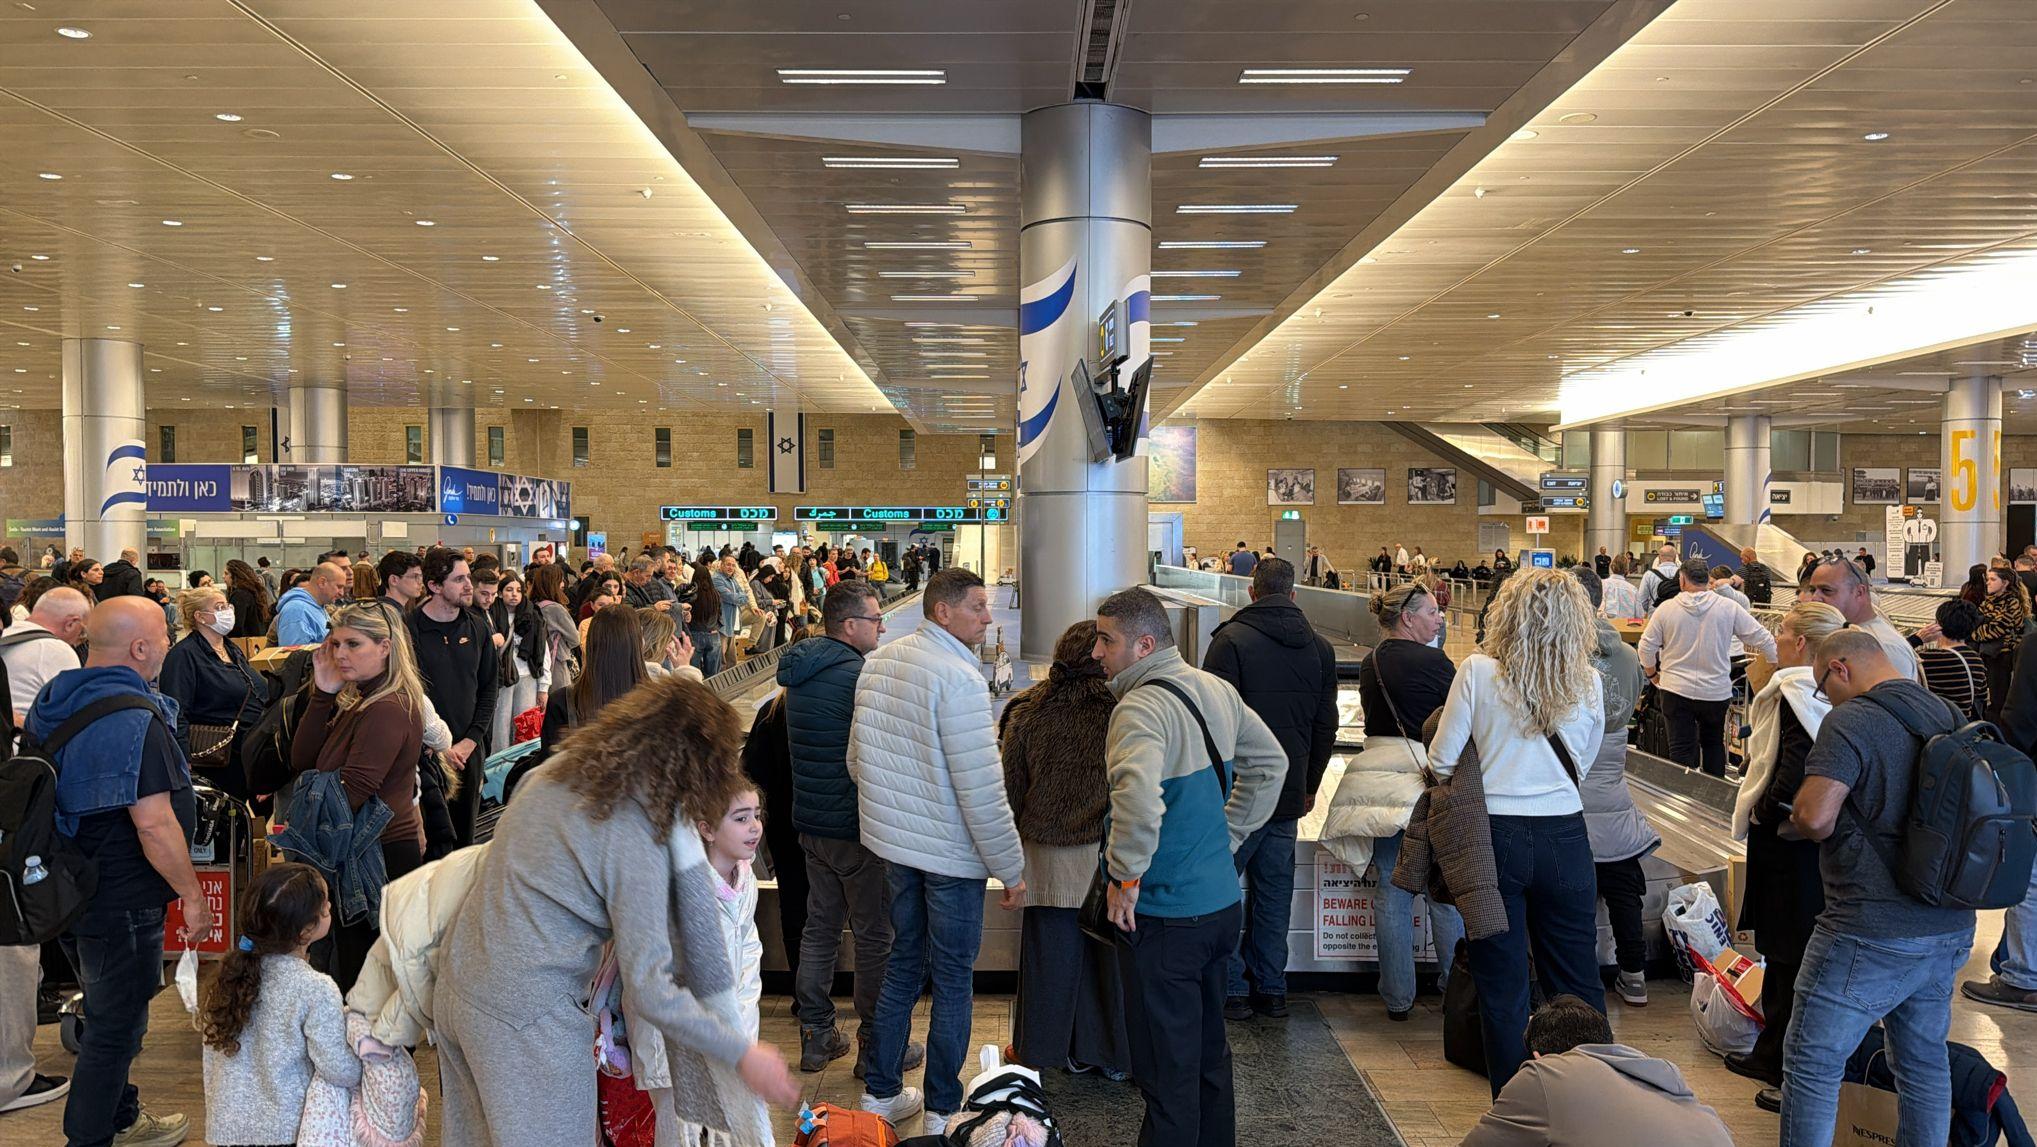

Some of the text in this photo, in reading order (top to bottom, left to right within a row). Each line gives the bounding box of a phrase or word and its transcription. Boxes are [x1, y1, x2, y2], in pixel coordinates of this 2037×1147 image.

[1951, 430, 1978, 512] 5
[194, 480, 217, 500] כאן
[487, 487, 496, 504] כאן
[669, 508, 717, 518] Customs
[740, 508, 769, 518] מכס
[808, 507, 837, 519] جمرك
[863, 508, 910, 518] Customs
[936, 508, 964, 519] מכס
[202, 880, 223, 895] אני
[1323, 898, 1368, 910] BEWARE
[1323, 914, 1366, 927] FALLING
[1322, 932, 1334, 940] Do
[1335, 932, 1348, 940] not
[1322, 942, 1356, 951] opposite
[1357, 942, 1370, 950] the
